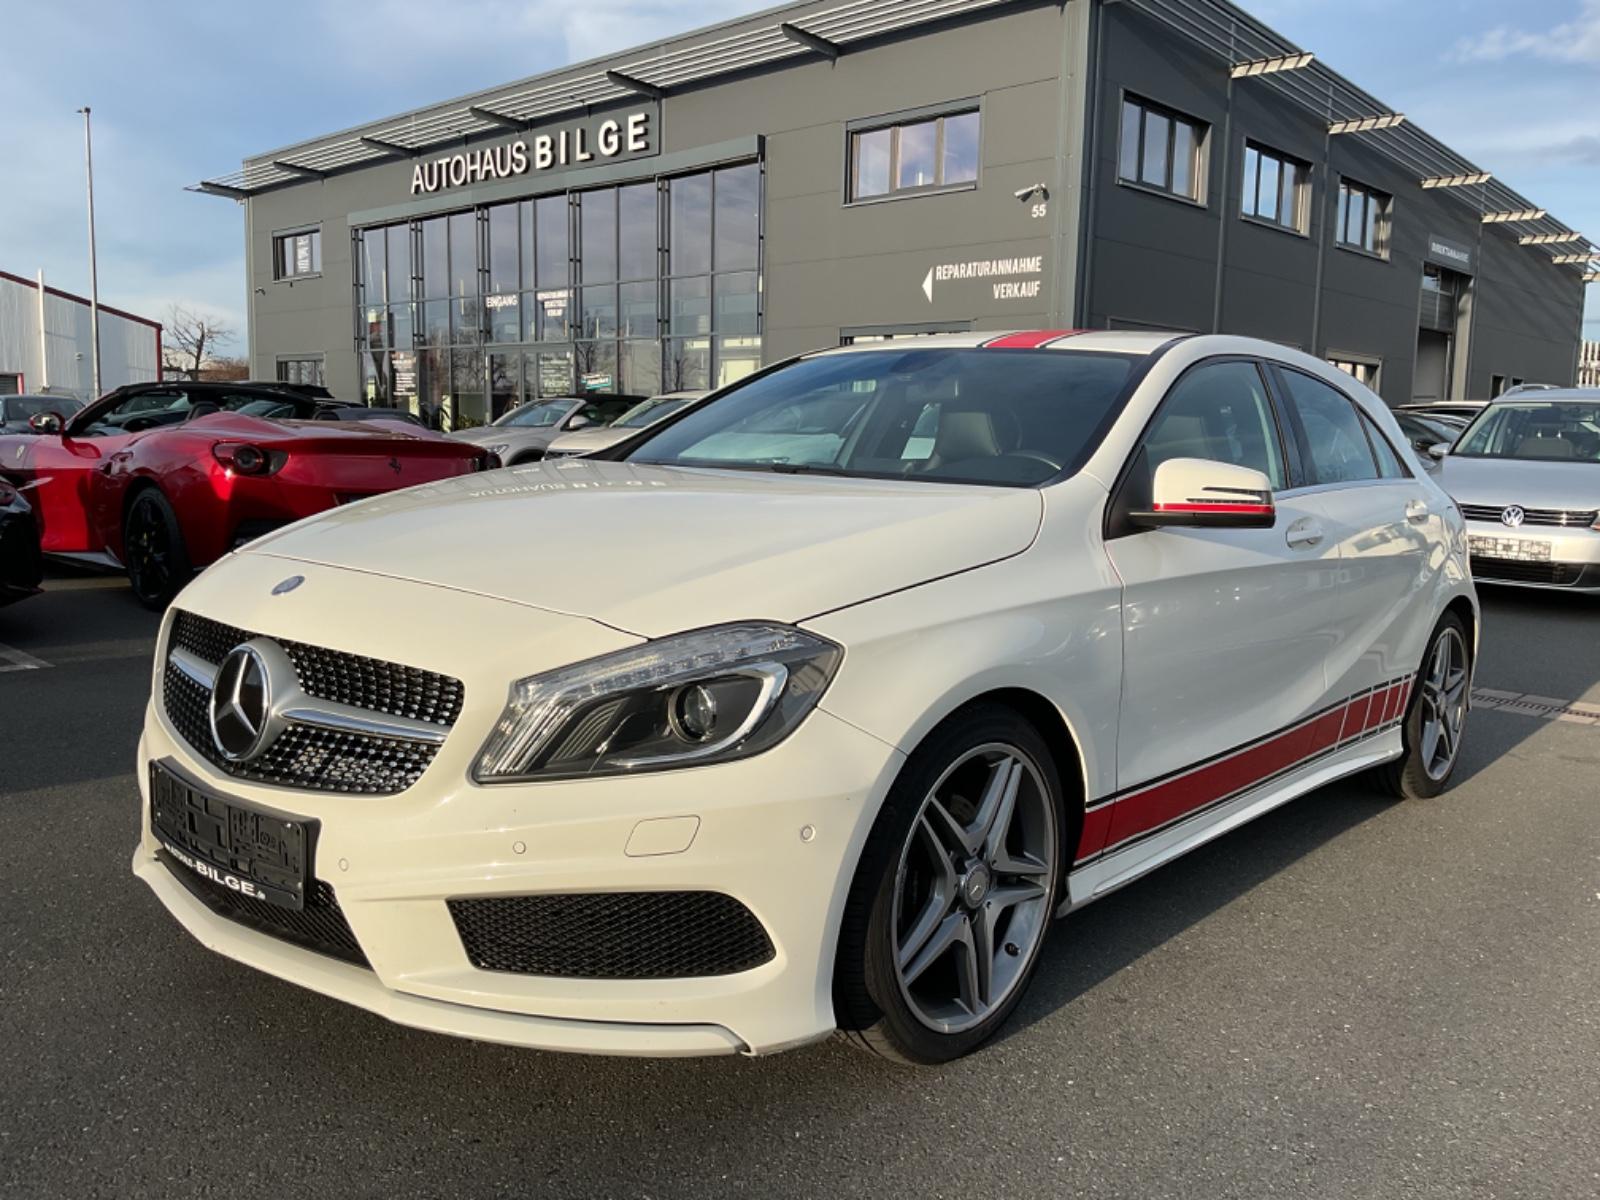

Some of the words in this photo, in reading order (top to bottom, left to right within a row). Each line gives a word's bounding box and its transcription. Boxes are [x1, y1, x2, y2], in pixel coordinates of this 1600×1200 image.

[411, 140, 528, 194] AUTOHAUS
[535, 112, 648, 169] BILGE
[1031, 203, 1047, 218] 55
[936, 256, 1042, 281] REPARATURANNAHME
[993, 280, 1041, 299] VERKAUF
